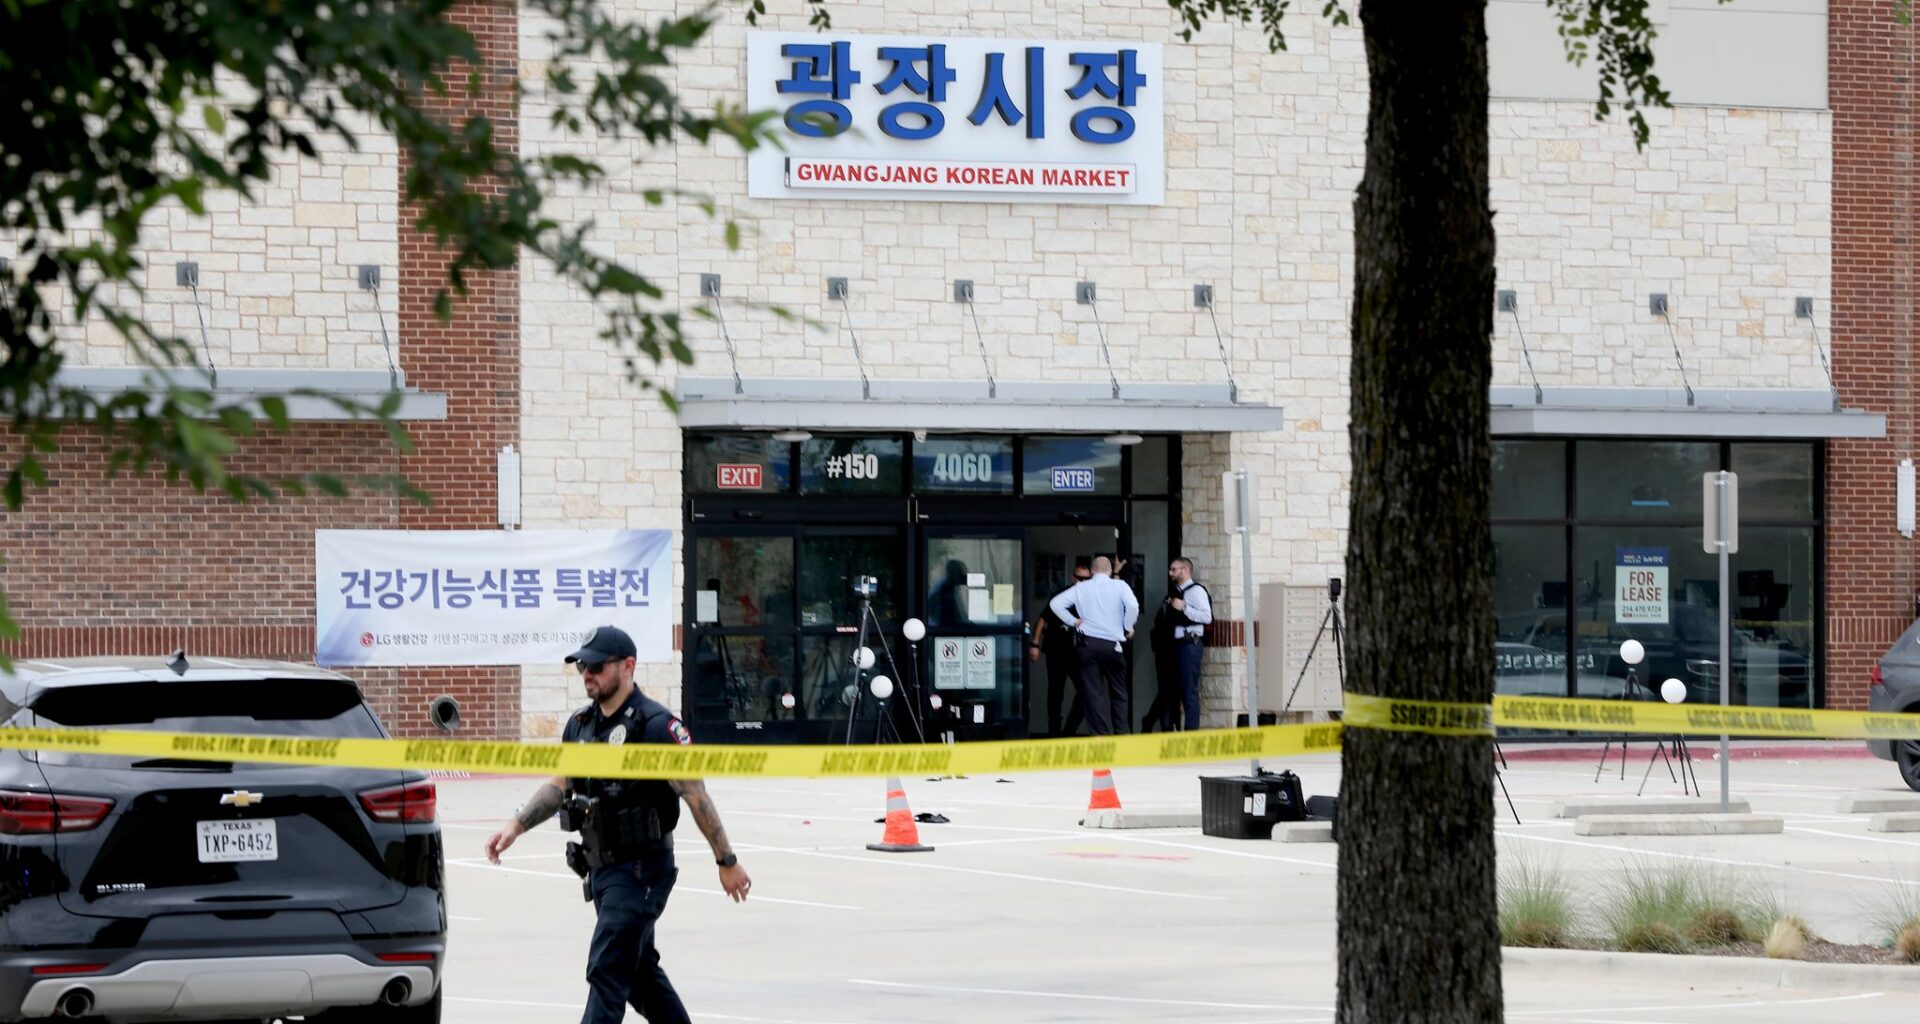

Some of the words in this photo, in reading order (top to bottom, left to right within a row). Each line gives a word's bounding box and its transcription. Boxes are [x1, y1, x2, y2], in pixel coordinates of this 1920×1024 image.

[775, 40, 1146, 144] 광장시장
[797, 164, 938, 184] GWANGJANG
[946, 167, 1034, 185] KOREAN
[1042, 169, 1130, 187] MARKET
[720, 467, 758, 486] EXIT
[826, 453, 879, 480] #150
[933, 453, 992, 482] 4060
[1054, 470, 1092, 488] ENTER
[340, 568, 543, 609] 건강기능식품
[553, 567, 649, 608] 특별전
[1629, 571, 1654, 586] FOR
[1622, 587, 1661, 602] LEASE
[1391, 703, 1437, 727] CROSS
[223, 822, 252, 831] TEXAS
